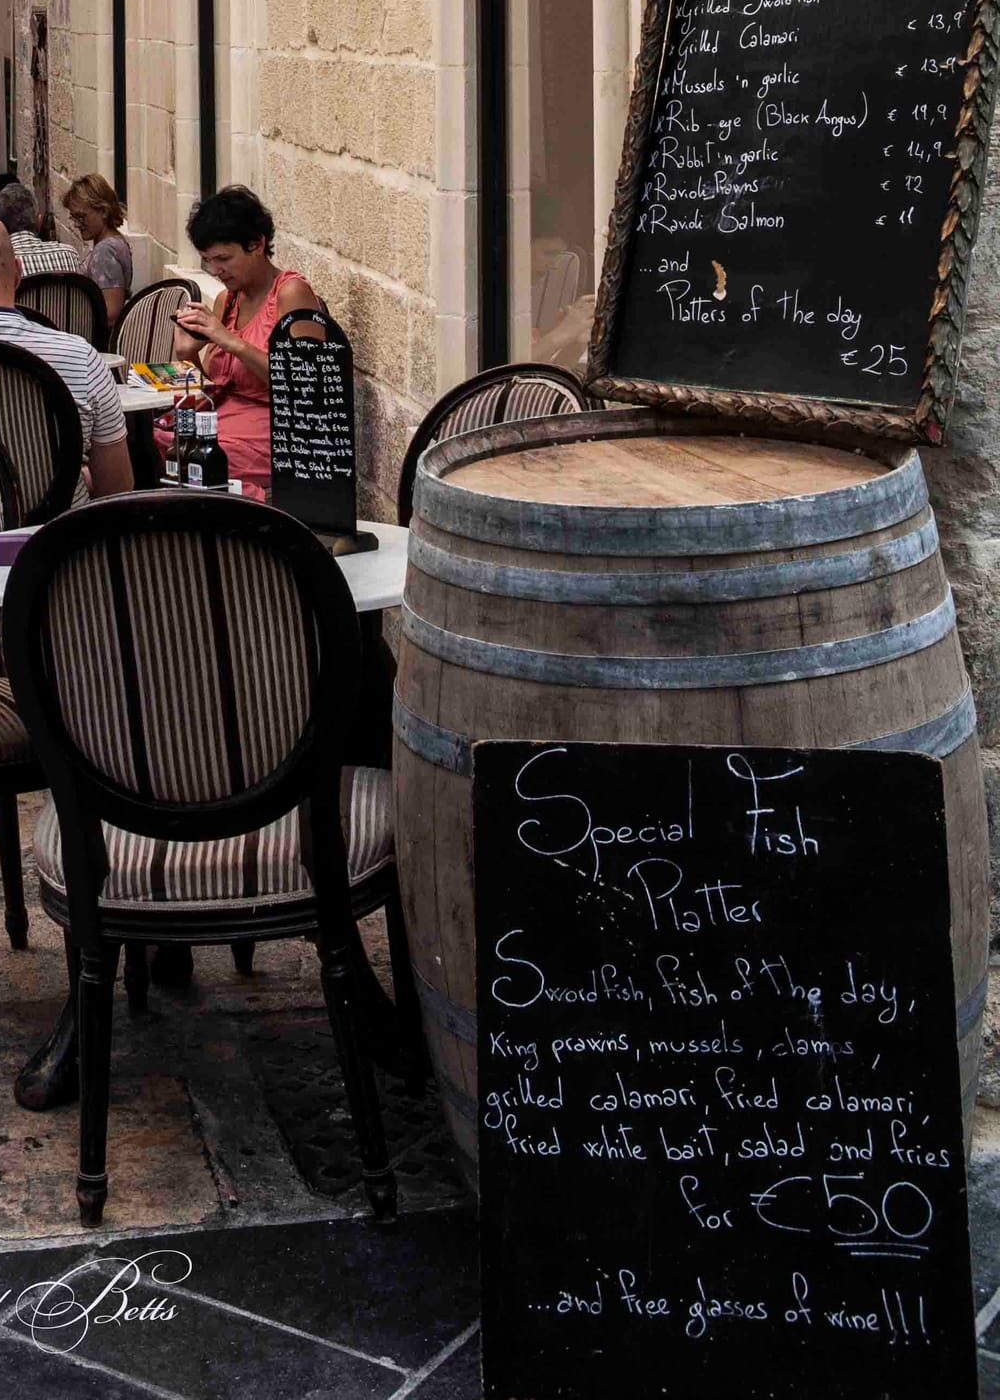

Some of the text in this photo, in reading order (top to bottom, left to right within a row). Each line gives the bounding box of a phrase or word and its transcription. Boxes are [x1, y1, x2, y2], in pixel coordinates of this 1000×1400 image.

[739, 22, 800, 50] Calamari
[669, 70, 725, 95] Mussels
[756, 63, 800, 98] garlic
[756, 101, 809, 130] (Black
[815, 91, 868, 137] Angus)
[736, 138, 779, 174] garlic
[717, 201, 785, 233] Salmon
[656, 279, 862, 340] Platters of the day
[515, 747, 820, 882] Special Fish
[627, 858, 762, 932] Platter
[656, 955, 718, 1004] fish
[731, 957, 754, 1001] of
[759, 955, 822, 1003] the
[490, 1032, 539, 1071] King
[484, 1072, 563, 1128] grilled
[590, 1072, 709, 1115] calamari,
[715, 1067, 779, 1110] fried
[504, 1114, 561, 1156] fried
[583, 1123, 647, 1161] white
[738, 1122, 806, 1158] salad
[830, 1129, 873, 1161] and
[891, 1119, 950, 1168] fries
[679, 1175, 736, 1229] for
[618, 1269, 670, 1316] free
[685, 1277, 768, 1338] glasses
[784, 1271, 811, 1325] of
